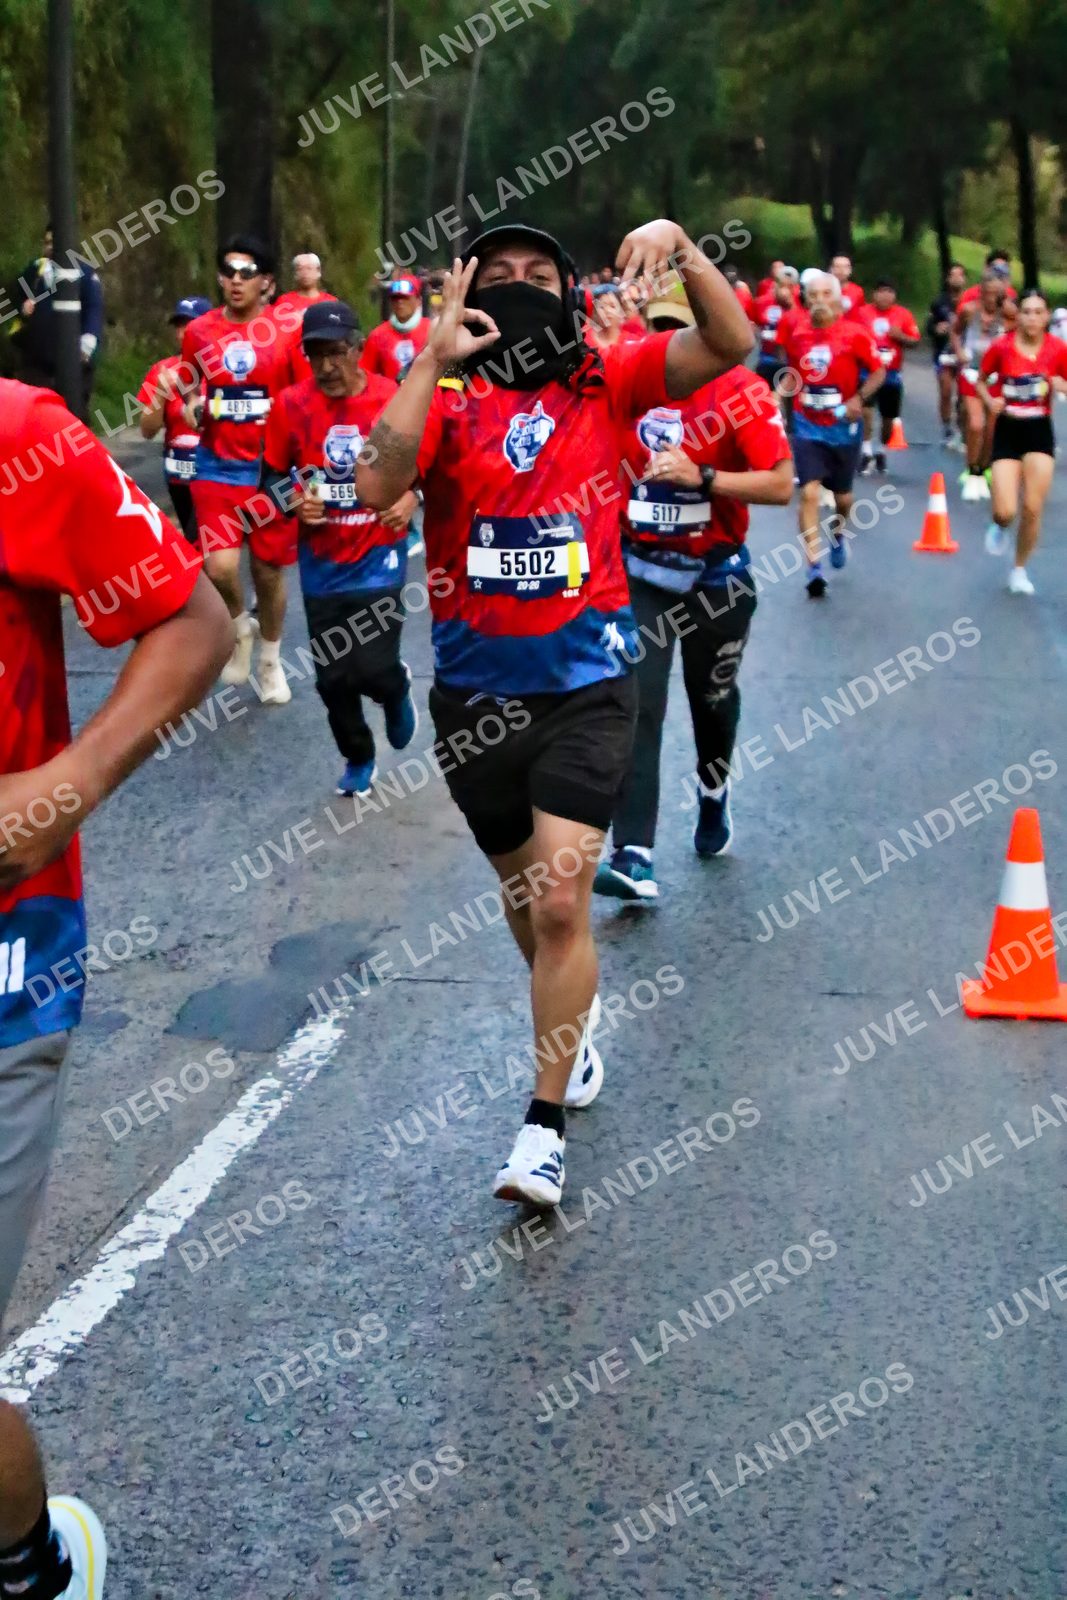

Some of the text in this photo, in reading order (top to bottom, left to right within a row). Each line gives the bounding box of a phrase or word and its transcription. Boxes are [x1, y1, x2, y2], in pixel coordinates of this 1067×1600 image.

[330, 485, 354, 499] 569
[652, 505, 682, 522] 5117
[500, 550, 556, 576] 5502
